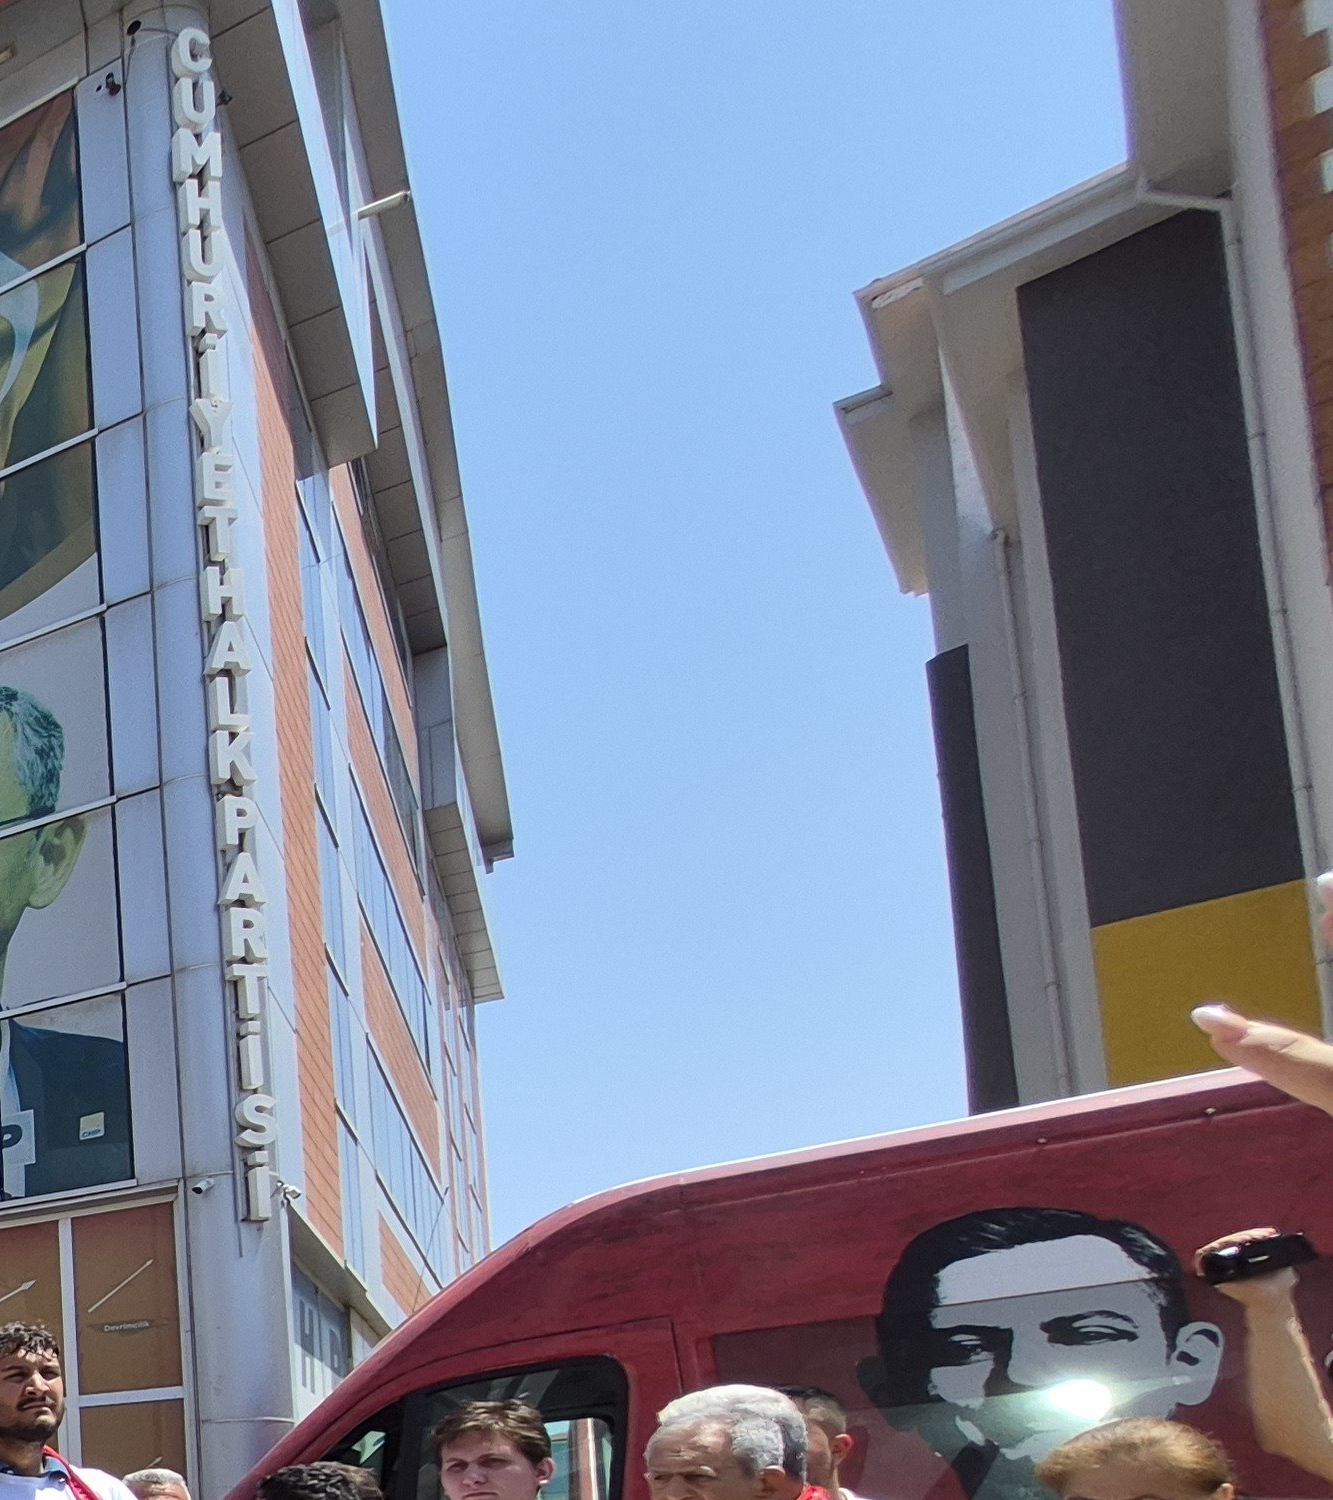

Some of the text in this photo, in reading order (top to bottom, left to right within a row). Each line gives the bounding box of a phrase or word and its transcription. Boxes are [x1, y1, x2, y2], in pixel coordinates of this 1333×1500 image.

[170, 27, 277, 1222] CUMHURİYET HALK PARTİSİ
